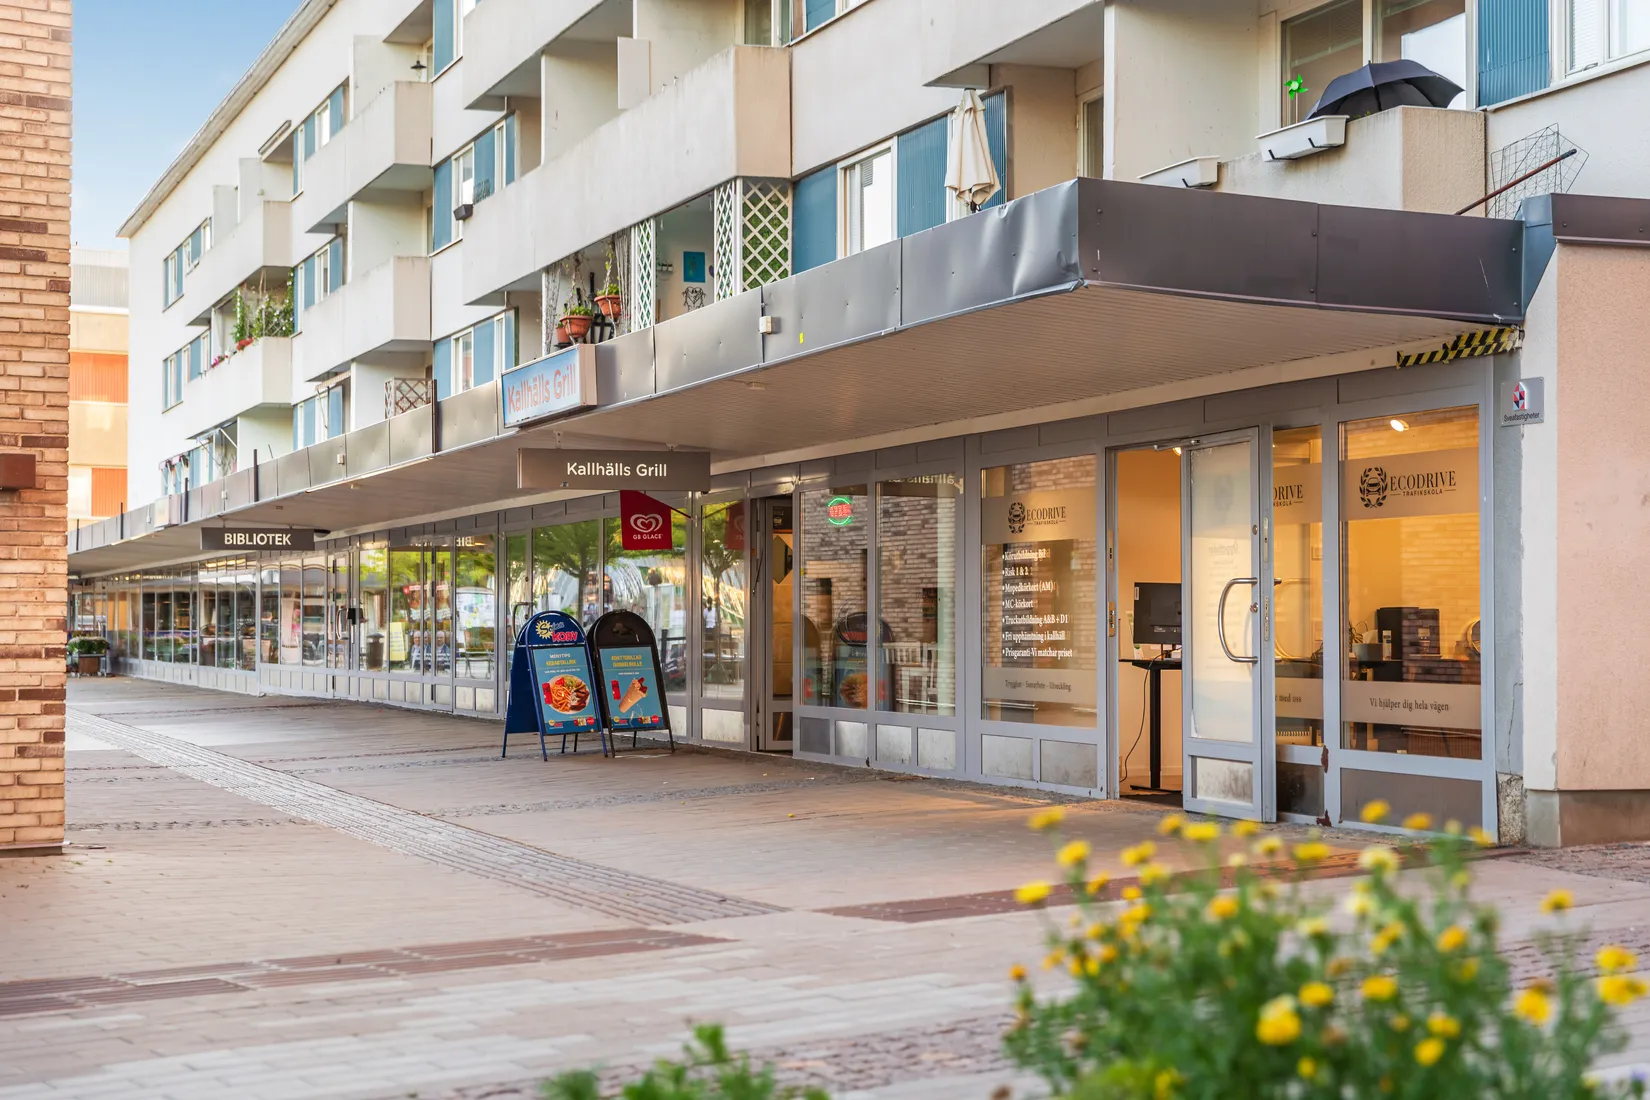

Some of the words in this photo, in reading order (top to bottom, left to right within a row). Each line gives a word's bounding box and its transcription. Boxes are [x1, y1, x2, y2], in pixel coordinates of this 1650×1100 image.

[507, 373, 550, 413] Kallhälls
[553, 362, 577, 400] Grill
[566, 462, 631, 477] Kallhälls
[635, 463, 668, 477] Grill
[1390, 470, 1457, 492] ECODRIVE
[1402, 489, 1443, 497] TRAFIKSKOLA
[1026, 506, 1067, 521] ECODRIVE
[223, 533, 292, 546] BIBLIOTEK
[1004, 566, 1016, 576] Risk
[1020, 566, 1025, 576] &
[1004, 581, 1039, 595] Mopedkörkort
[1039, 579, 1053, 593] (AM)
[1004, 598, 1034, 609] MC-körkort
[1043, 614, 1056, 625] A&B
[1060, 613, 1069, 624] D1
[552, 631, 579, 642] KORV
[1004, 631, 1013, 641] Fri
[1013, 631, 1045, 643] upphämtning
[1038, 647, 1058, 657] matchar
[1058, 648, 1073, 660] priset
[1369, 697, 1377, 707] Vi
[1378, 697, 1401, 711] hjälper
[1402, 698, 1413, 712] dig
[1414, 699, 1428, 710] hela
[1429, 700, 1449, 714] vägen
